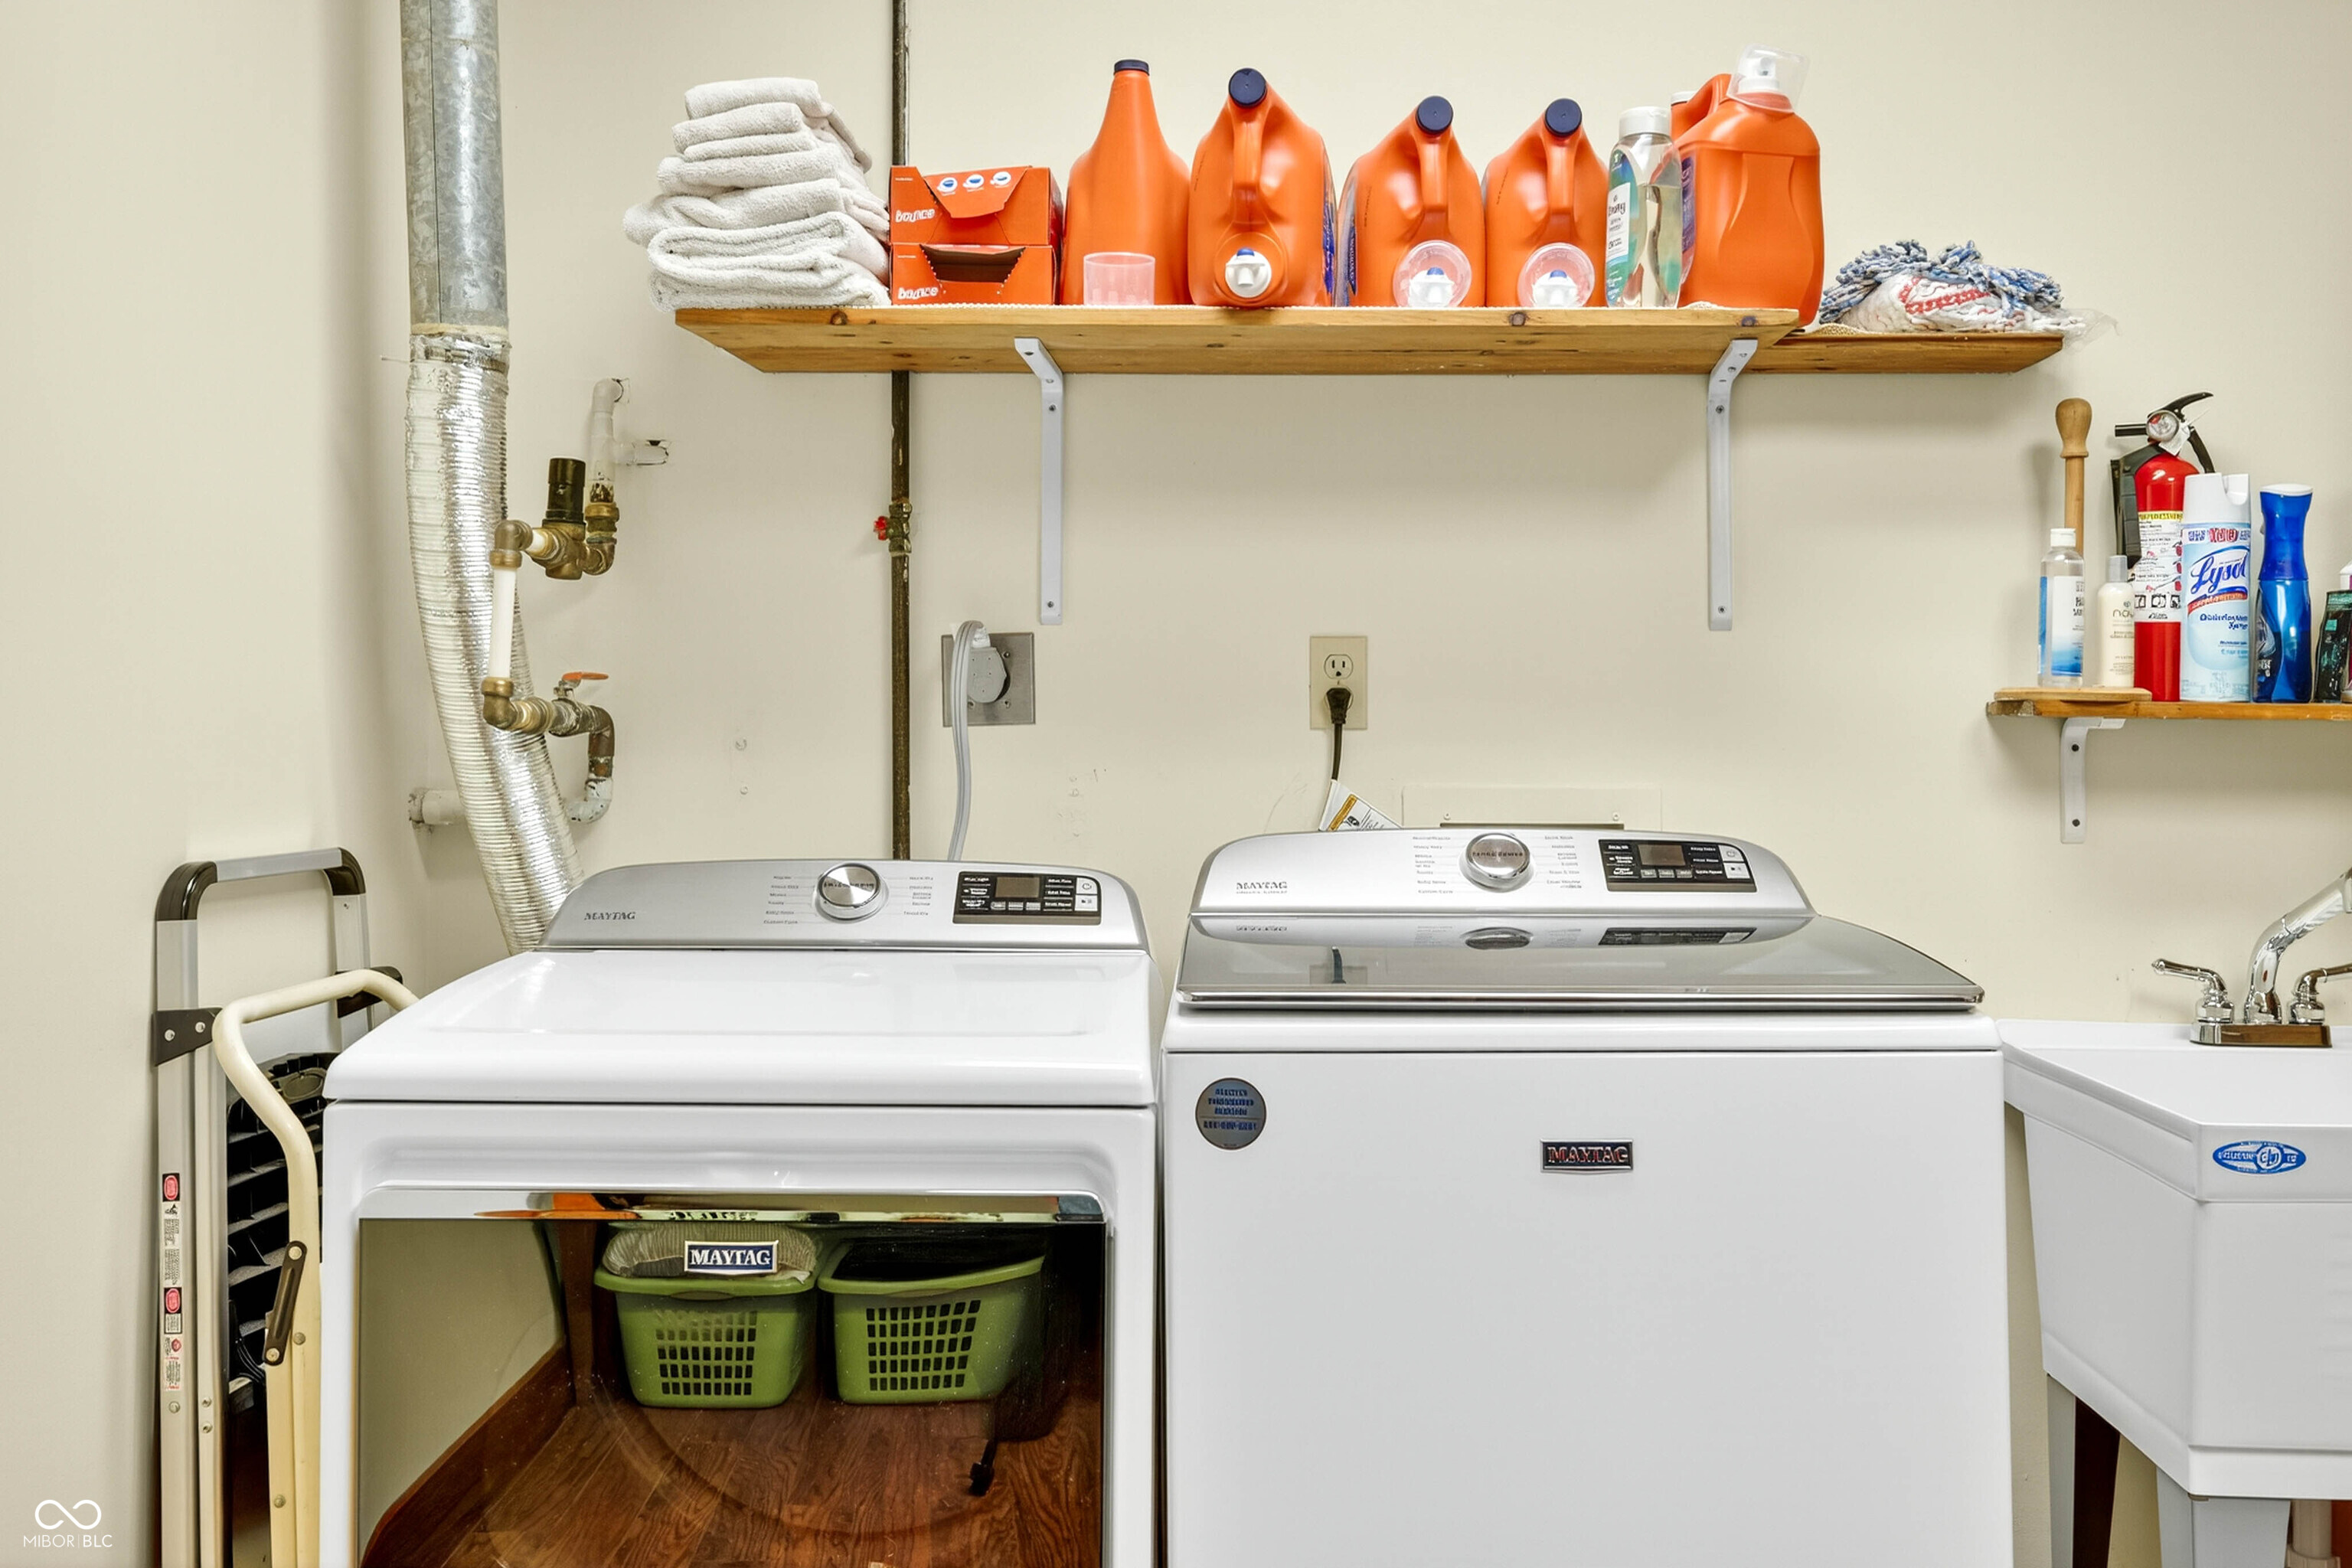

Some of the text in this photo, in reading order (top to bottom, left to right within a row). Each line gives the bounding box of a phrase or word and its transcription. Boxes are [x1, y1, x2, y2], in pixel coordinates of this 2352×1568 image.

[2190, 551, 2249, 596] Lysol
[1547, 1145, 1628, 1164] MAYTAG
[689, 1249, 772, 1266] MAYTAG
